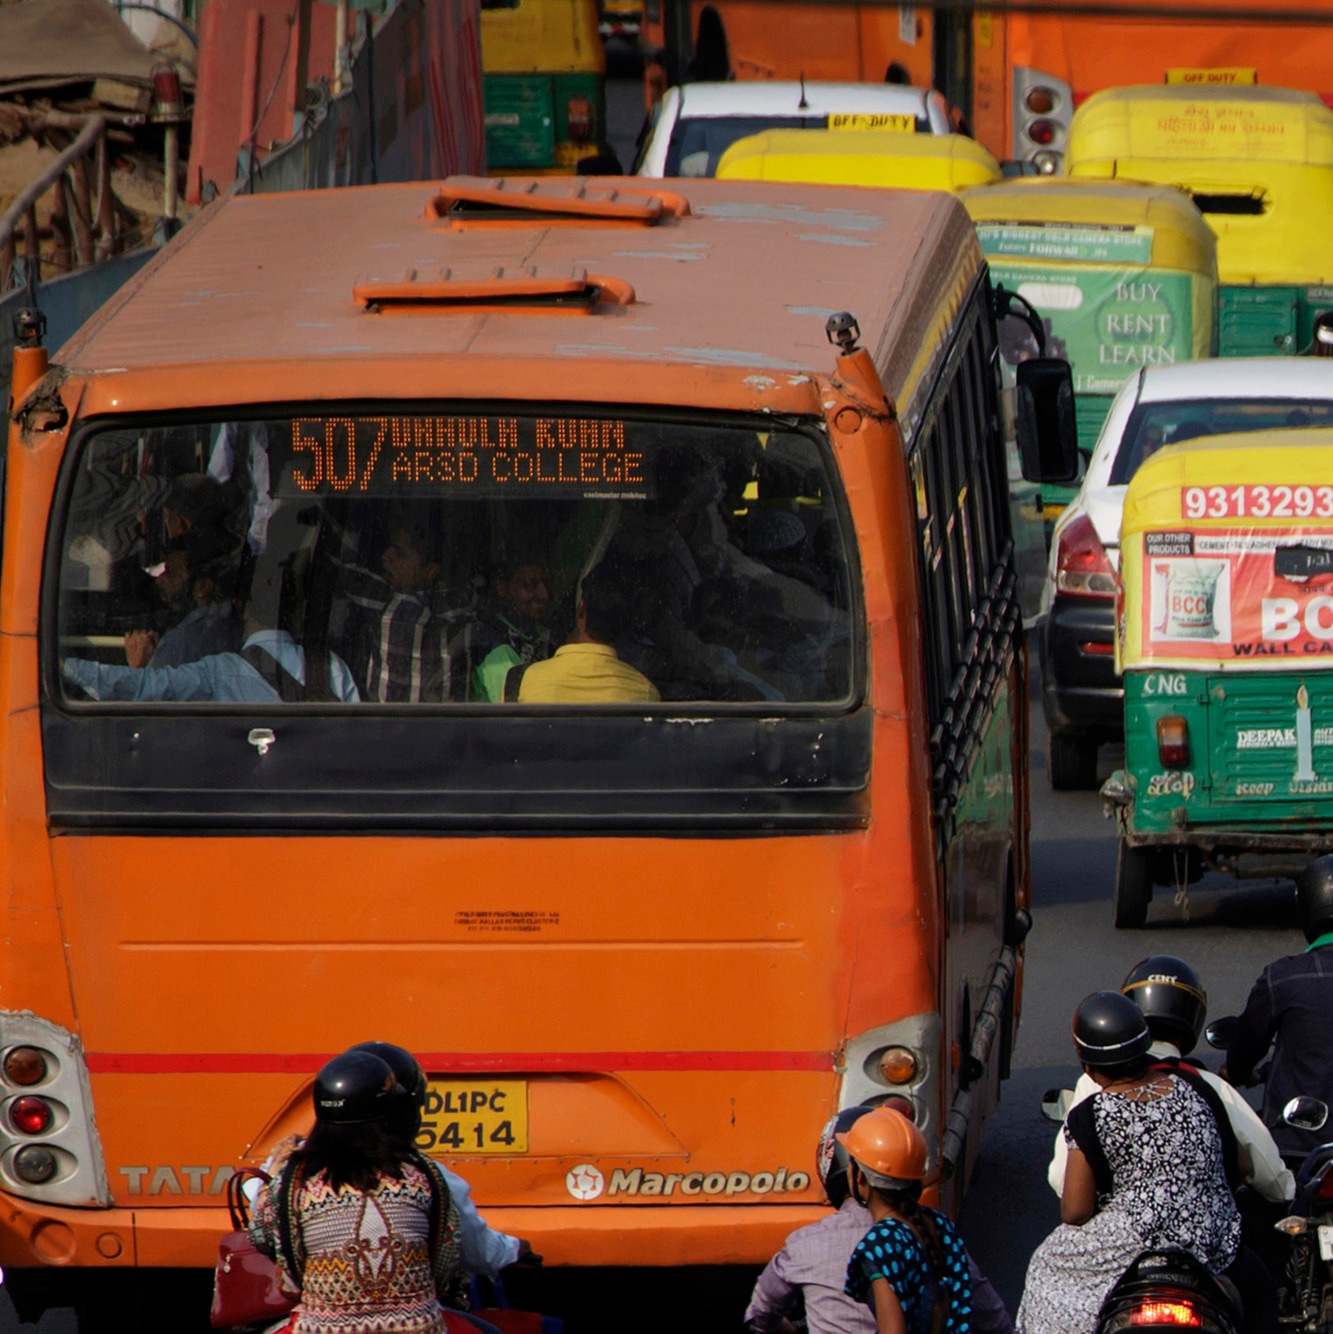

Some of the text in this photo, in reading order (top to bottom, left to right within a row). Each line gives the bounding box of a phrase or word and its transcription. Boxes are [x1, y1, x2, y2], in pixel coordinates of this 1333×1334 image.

[1208, 73, 1236, 83] DUTY
[1116, 283, 1163, 301] BUY
[1106, 314, 1169, 334] RENT
[1099, 345, 1175, 365] LEARN
[292, 417, 388, 490] 507
[393, 452, 644, 483] ARSD COLLEGE
[1147, 534, 1191, 543] OUR OTHER
[1200, 541, 1229, 550] CEMENT
[1149, 545, 1190, 555] PRODUCTS
[1171, 596, 1206, 614] BCC
[1232, 642, 1296, 656] WALL
[1144, 674, 1187, 696] CNG
[1237, 729, 1296, 743] DEEPAK
[1235, 781, 1274, 796] Keep
[414, 1121, 516, 1149] 5414
[607, 1166, 811, 1197] Marcopolo
